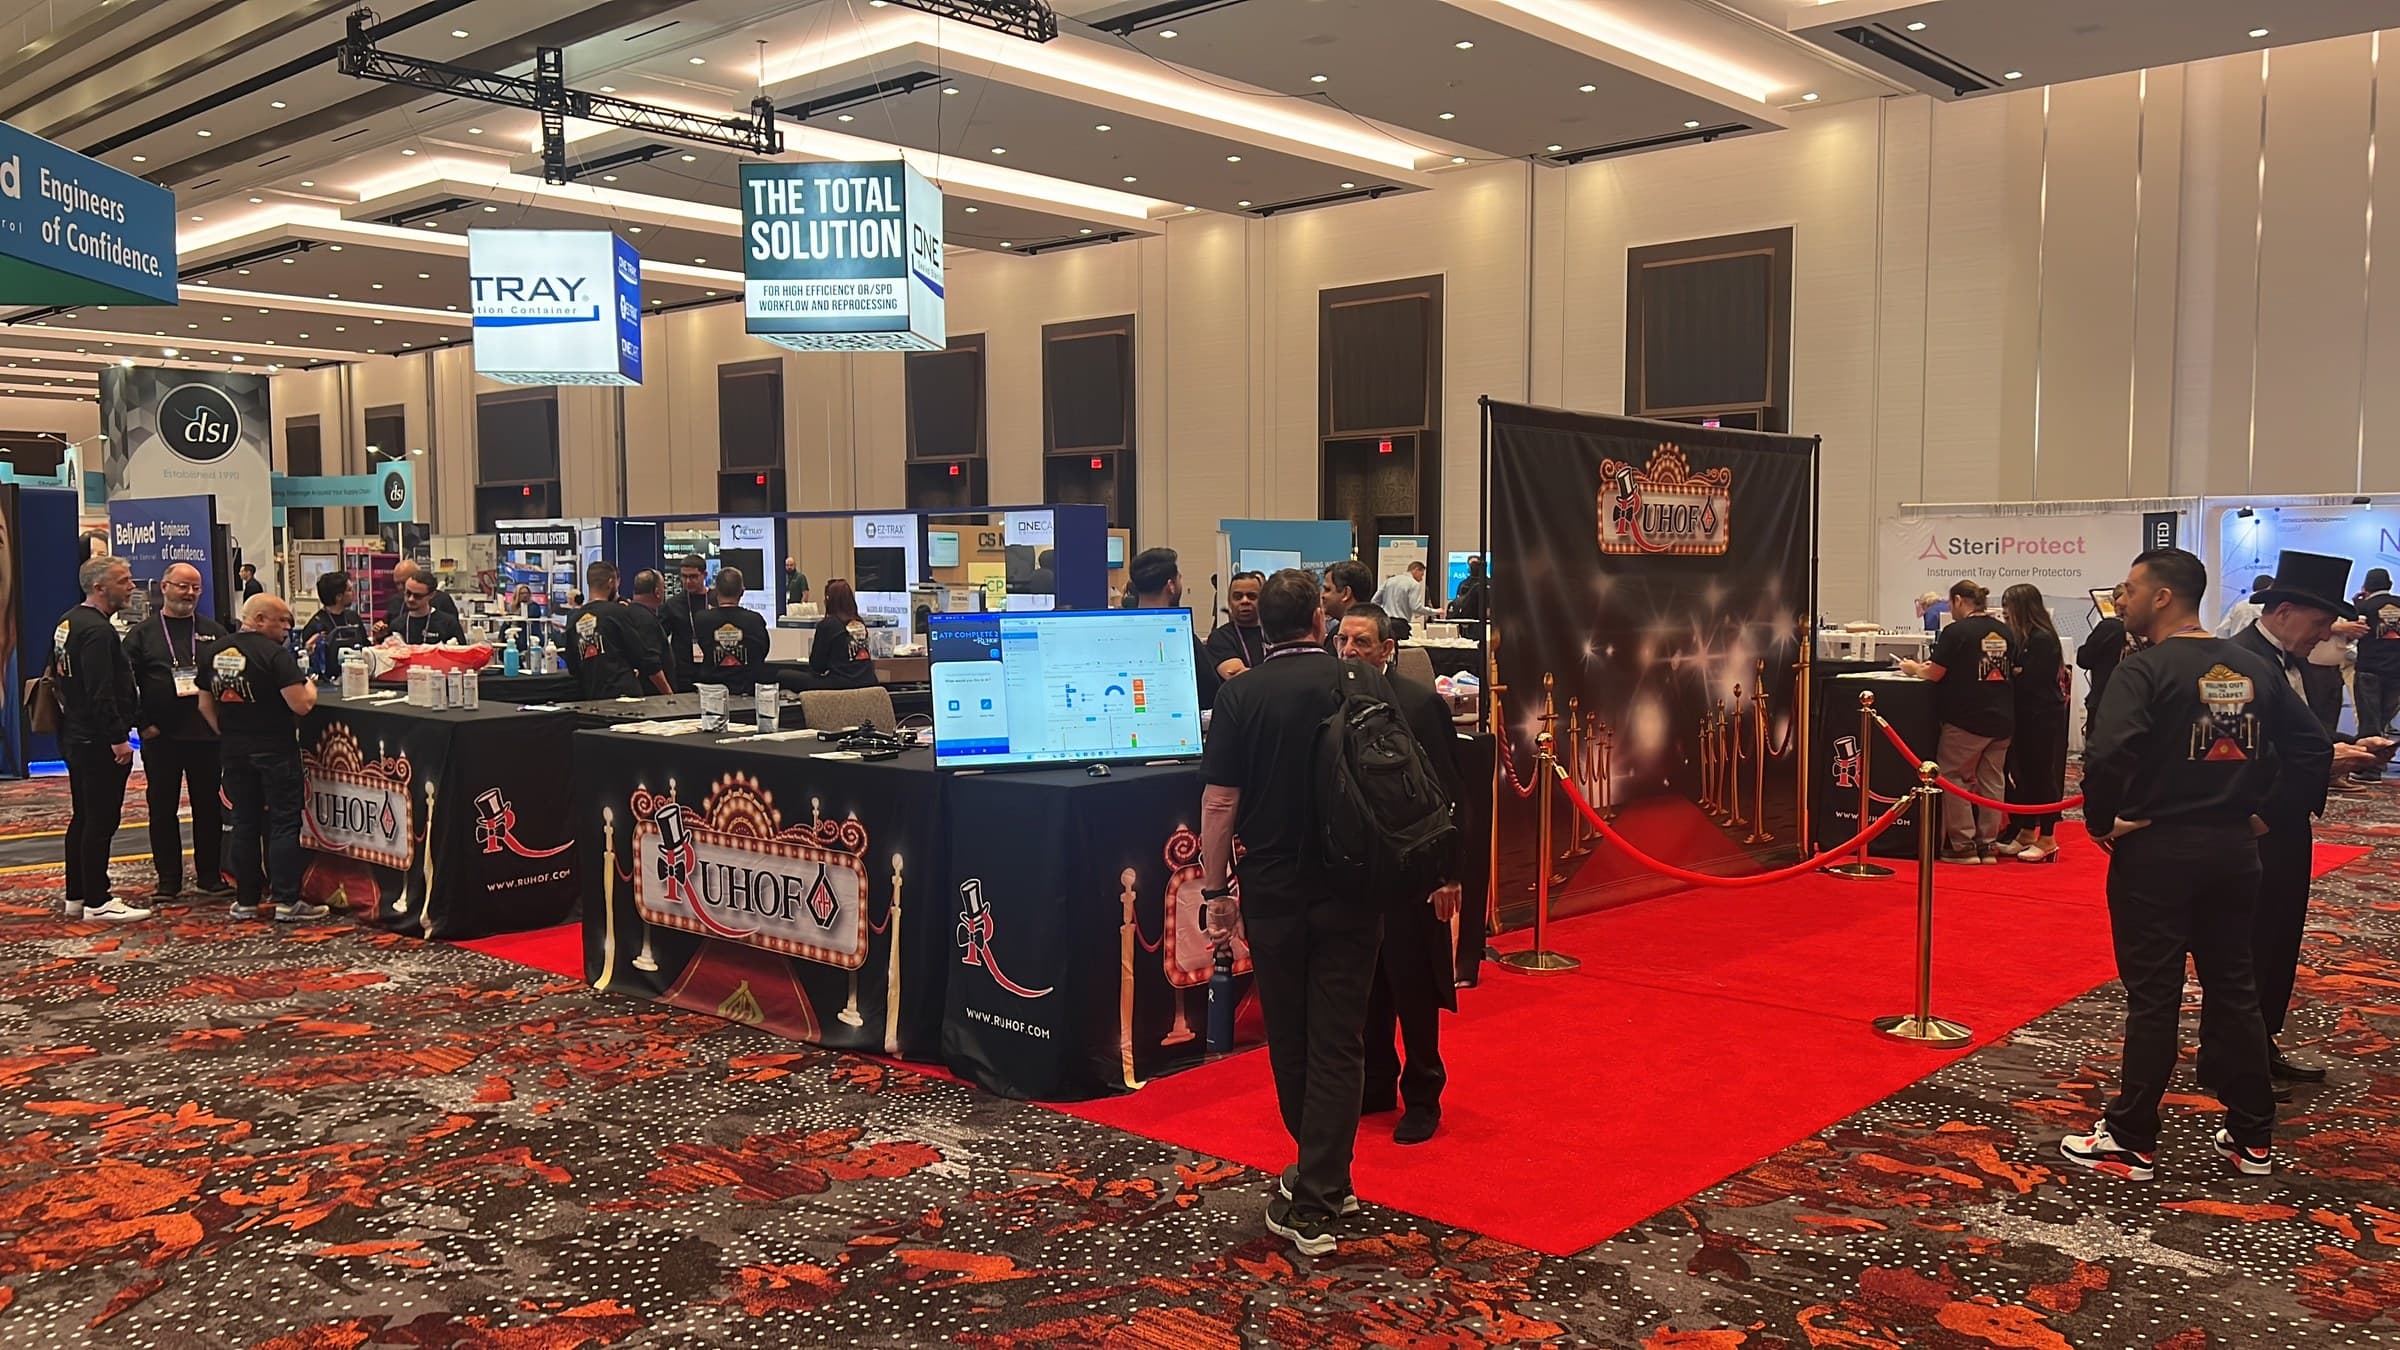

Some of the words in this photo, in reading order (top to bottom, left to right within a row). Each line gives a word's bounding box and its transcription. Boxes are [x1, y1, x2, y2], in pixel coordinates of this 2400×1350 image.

[40, 167, 125, 224] Engineers
[749, 179, 805, 215] THE
[814, 177, 900, 213] TOTAL
[41, 216, 61, 246] of
[66, 223, 163, 278] Confidence.
[751, 219, 902, 260] SOLUTION
[914, 223, 939, 268] ONE
[470, 276, 586, 302] TRAY
[763, 285, 780, 297] FOR
[783, 285, 803, 297] HIGH
[805, 284, 855, 296] EFFICIENCY
[858, 284, 893, 296] OR/SPD
[473, 306, 504, 315] tion
[511, 306, 577, 315] Container
[760, 300, 809, 312] WORKFLOW
[811, 300, 829, 311] AND
[832, 299, 898, 311] REPROCESSING
[160, 520, 190, 540] Engineers
[1613, 484, 1700, 552] RUHOF
[500, 533, 509, 545] THE
[510, 533, 524, 545] TOTAL
[525, 532, 548, 545] SOLUTION
[549, 532, 569, 544] SYSTEM
[978, 533, 996, 547] CS
[1949, 536, 2086, 555] SteriProtect
[2157, 522, 2169, 549] ITED
[162, 544, 169, 560] of
[1927, 567, 1977, 577] Instrument
[1979, 567, 1997, 579] Tray
[1999, 567, 2030, 577] Corner
[2032, 567, 2082, 577] Protectors
[659, 838, 803, 938] RUHOF
[966, 1007, 1050, 1040] WWW.RUHOF.COM
